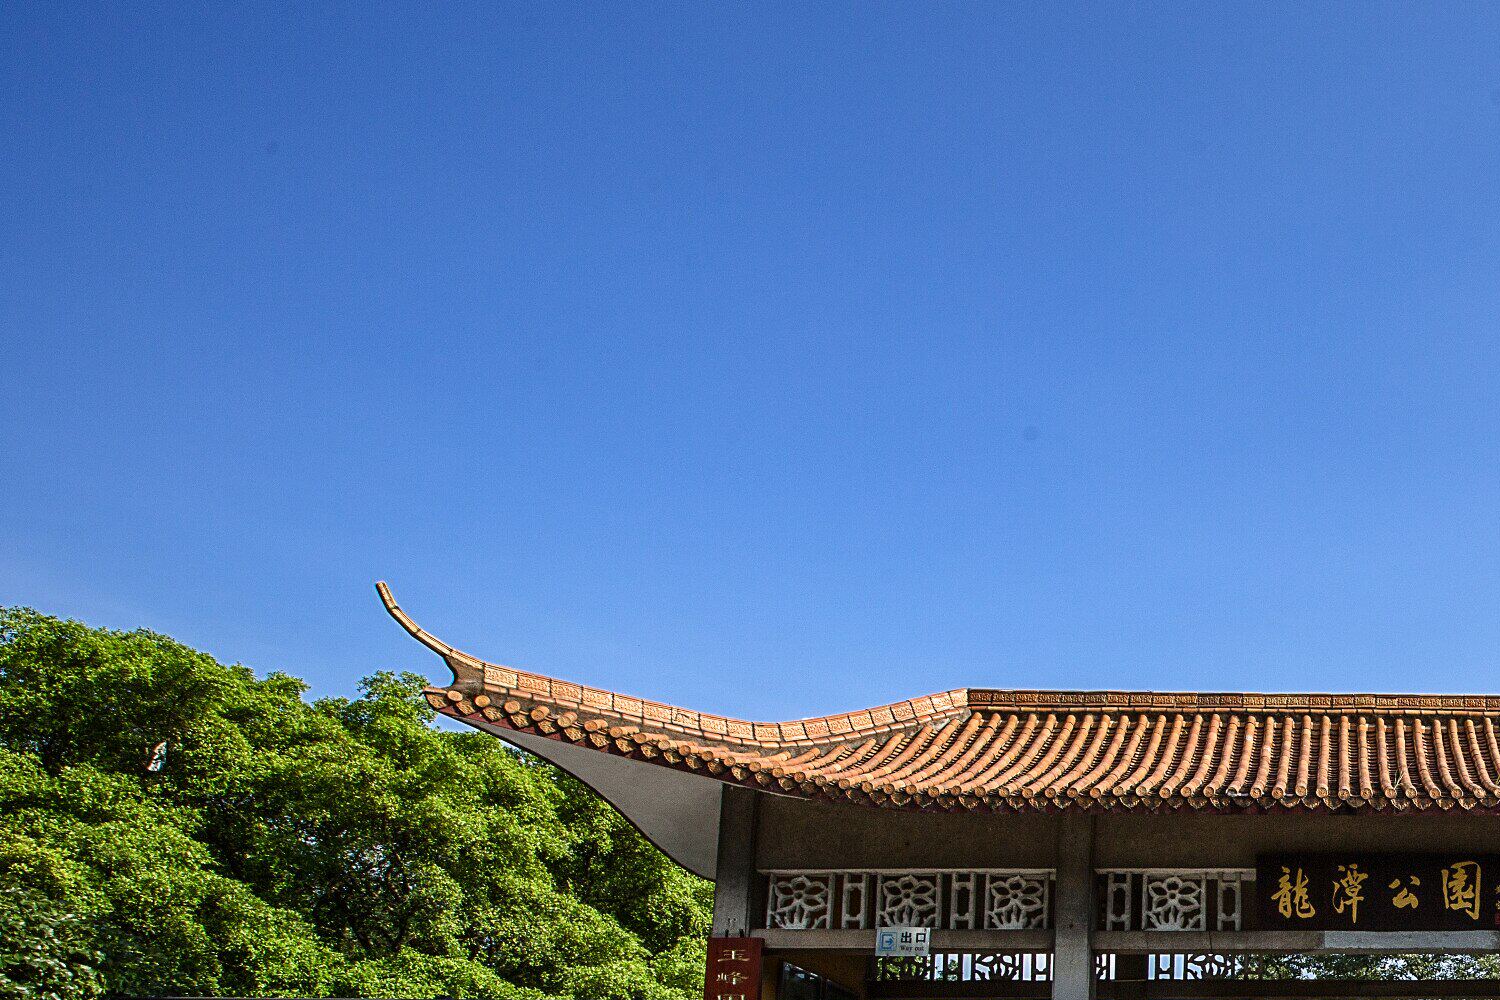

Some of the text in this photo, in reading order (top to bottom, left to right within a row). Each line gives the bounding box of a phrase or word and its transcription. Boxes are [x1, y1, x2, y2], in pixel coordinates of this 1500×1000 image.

[1270, 860, 1482, 924] 龍潭公園
[900, 931, 927, 943] 出口
